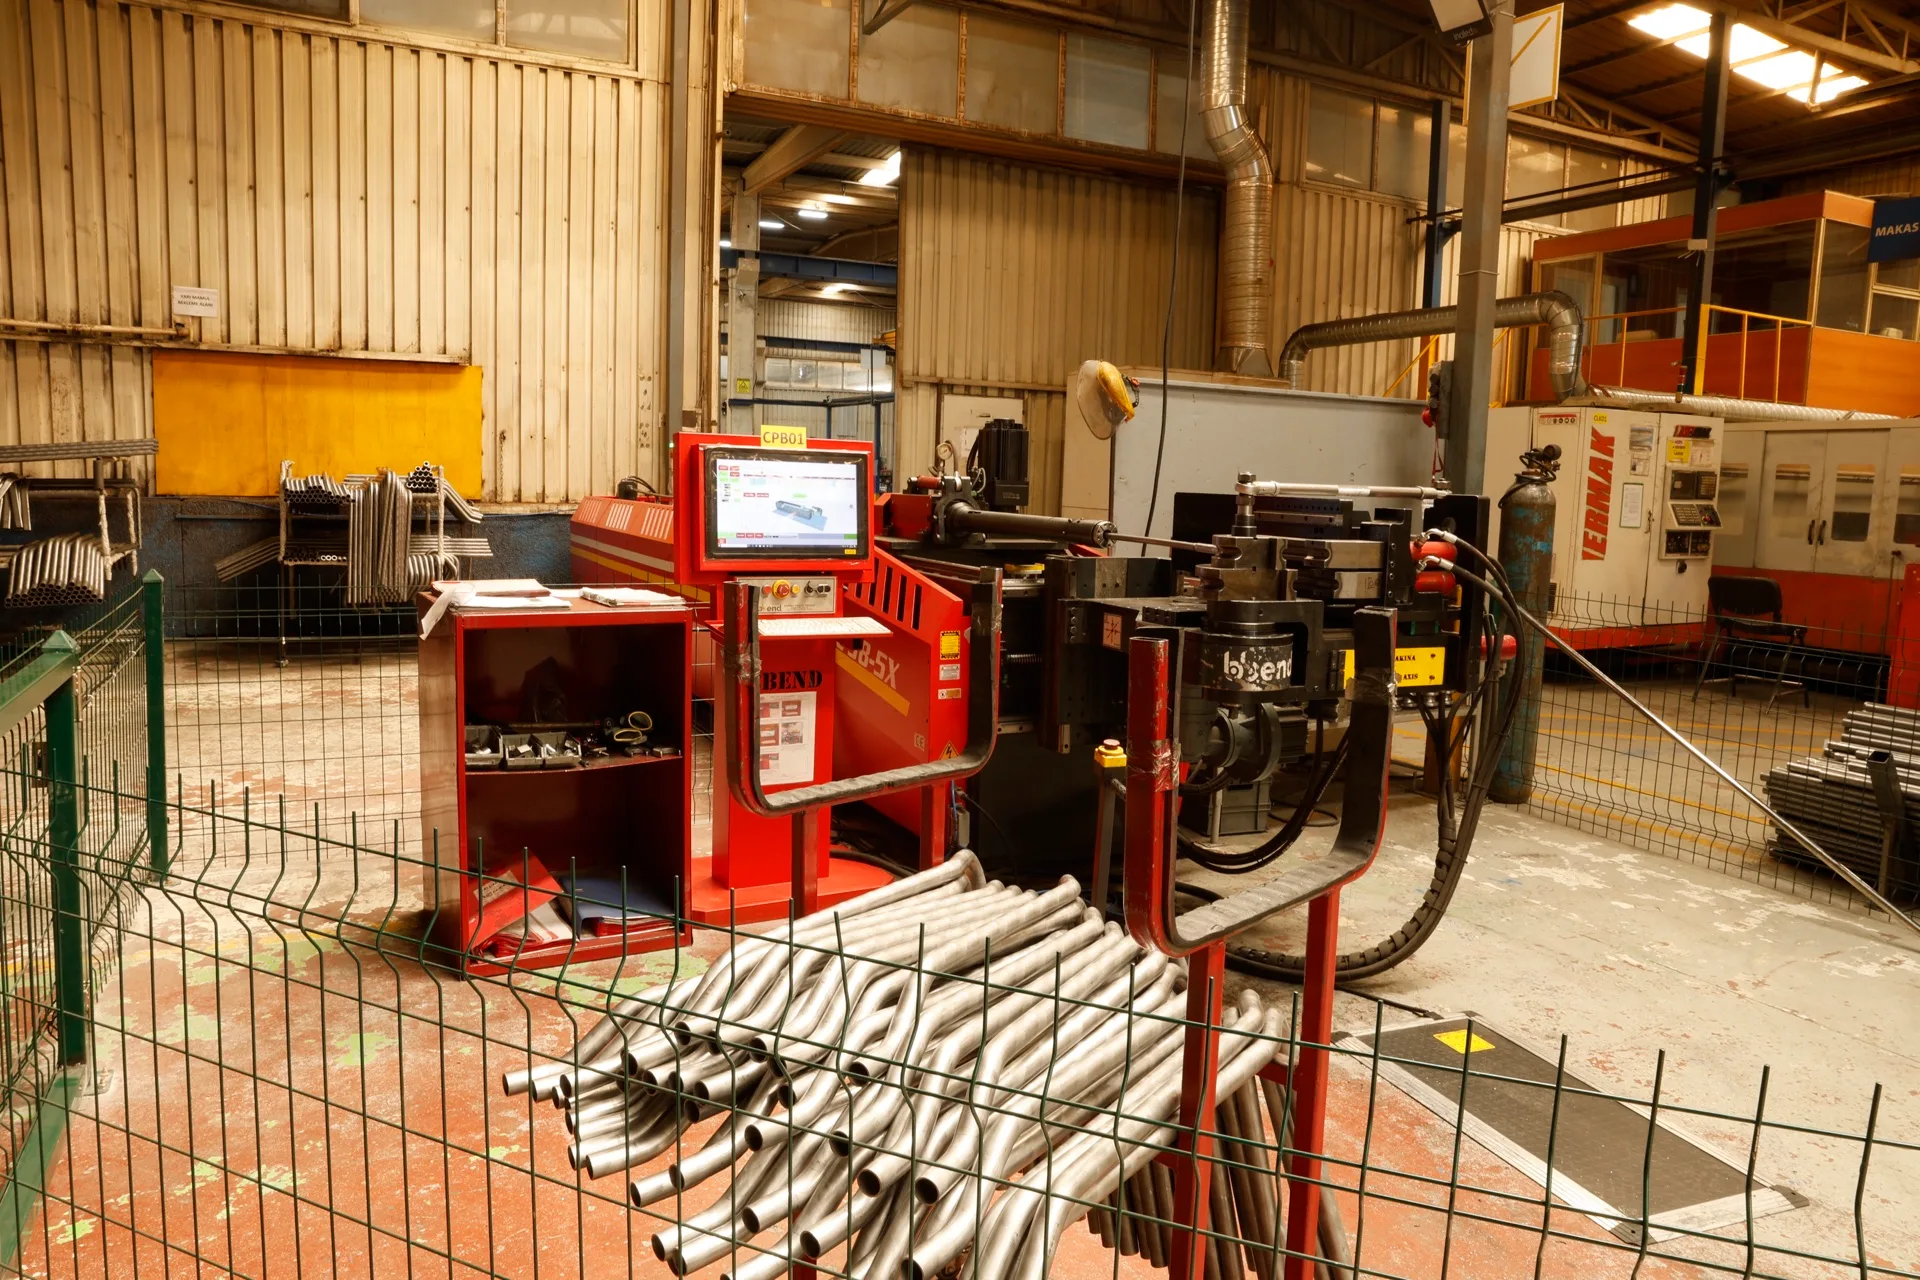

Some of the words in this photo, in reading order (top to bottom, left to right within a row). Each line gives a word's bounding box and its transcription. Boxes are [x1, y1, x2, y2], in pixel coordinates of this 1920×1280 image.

[1875, 222, 1919, 238] MAKAS
[762, 431, 804, 445] CPB01
[762, 670, 823, 691] BEND
